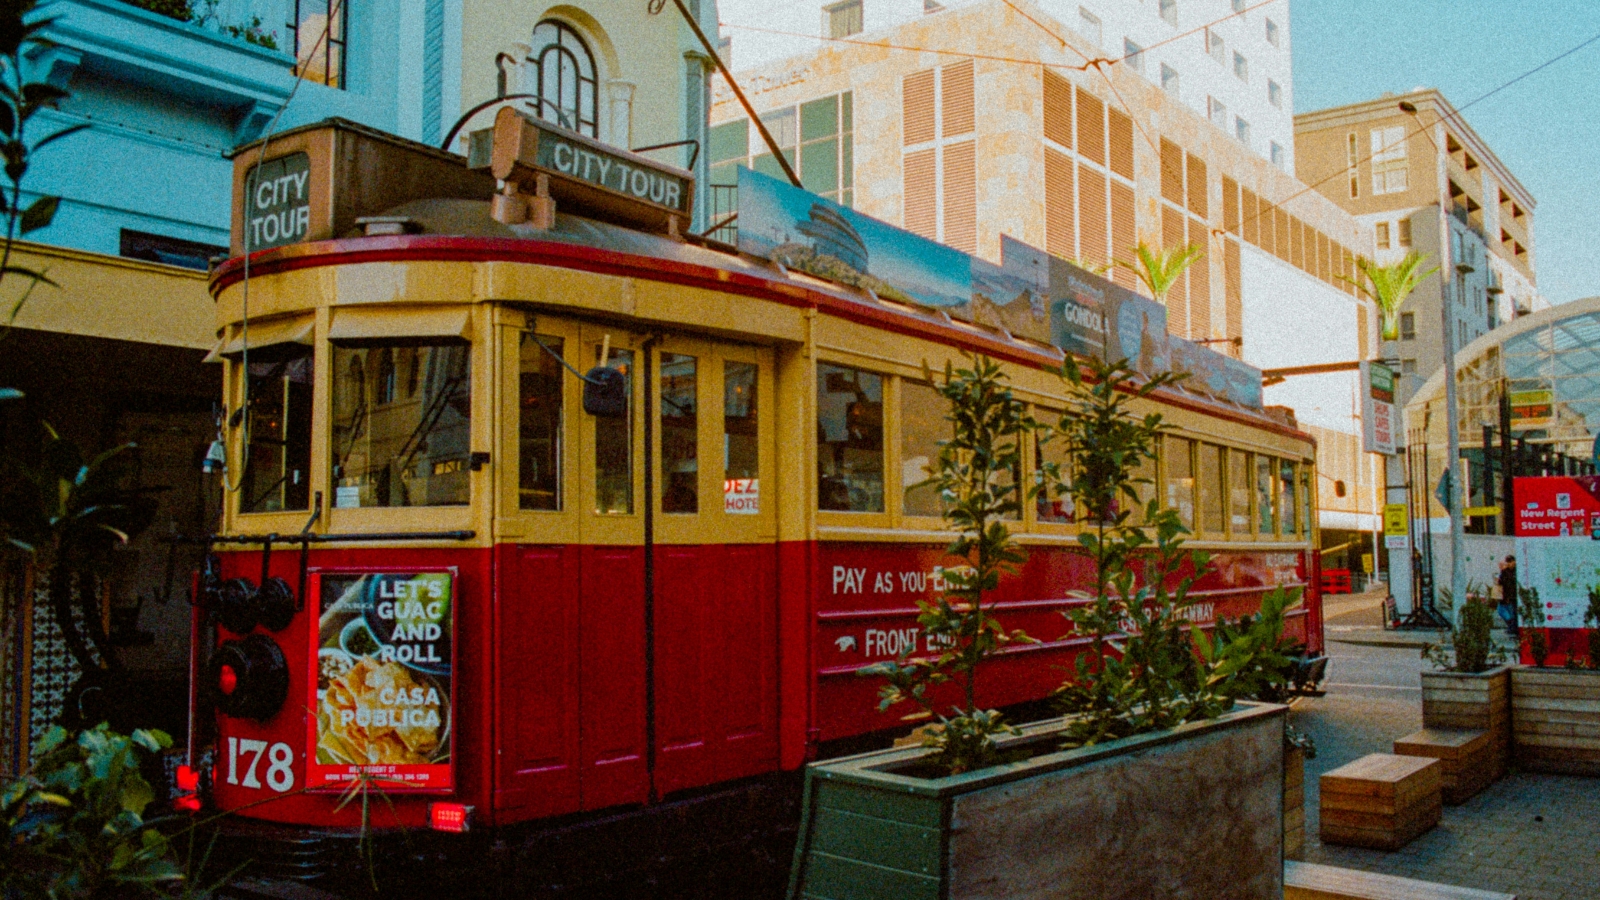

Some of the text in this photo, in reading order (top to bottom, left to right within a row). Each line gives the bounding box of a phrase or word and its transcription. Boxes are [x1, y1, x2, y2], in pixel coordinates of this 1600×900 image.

[554, 143, 680, 209] CITY TOUR
[257, 170, 309, 209] CITY
[252, 205, 310, 246] TOUR
[725, 498, 758, 510] HOTE
[1521, 508, 1585, 519] New Regent
[1521, 521, 1555, 530] Street
[833, 565, 866, 594] PAY
[873, 571, 893, 593] AS
[899, 571, 926, 592] YOU
[380, 580, 442, 598] LET'S
[377, 601, 442, 619] GUAC
[391, 623, 442, 640] AND
[865, 628, 919, 657] FRONT
[381, 644, 442, 662] ROLL
[380, 687, 440, 706] CASA
[341, 709, 440, 727] PUBLICA
[227, 737, 294, 793] 178
